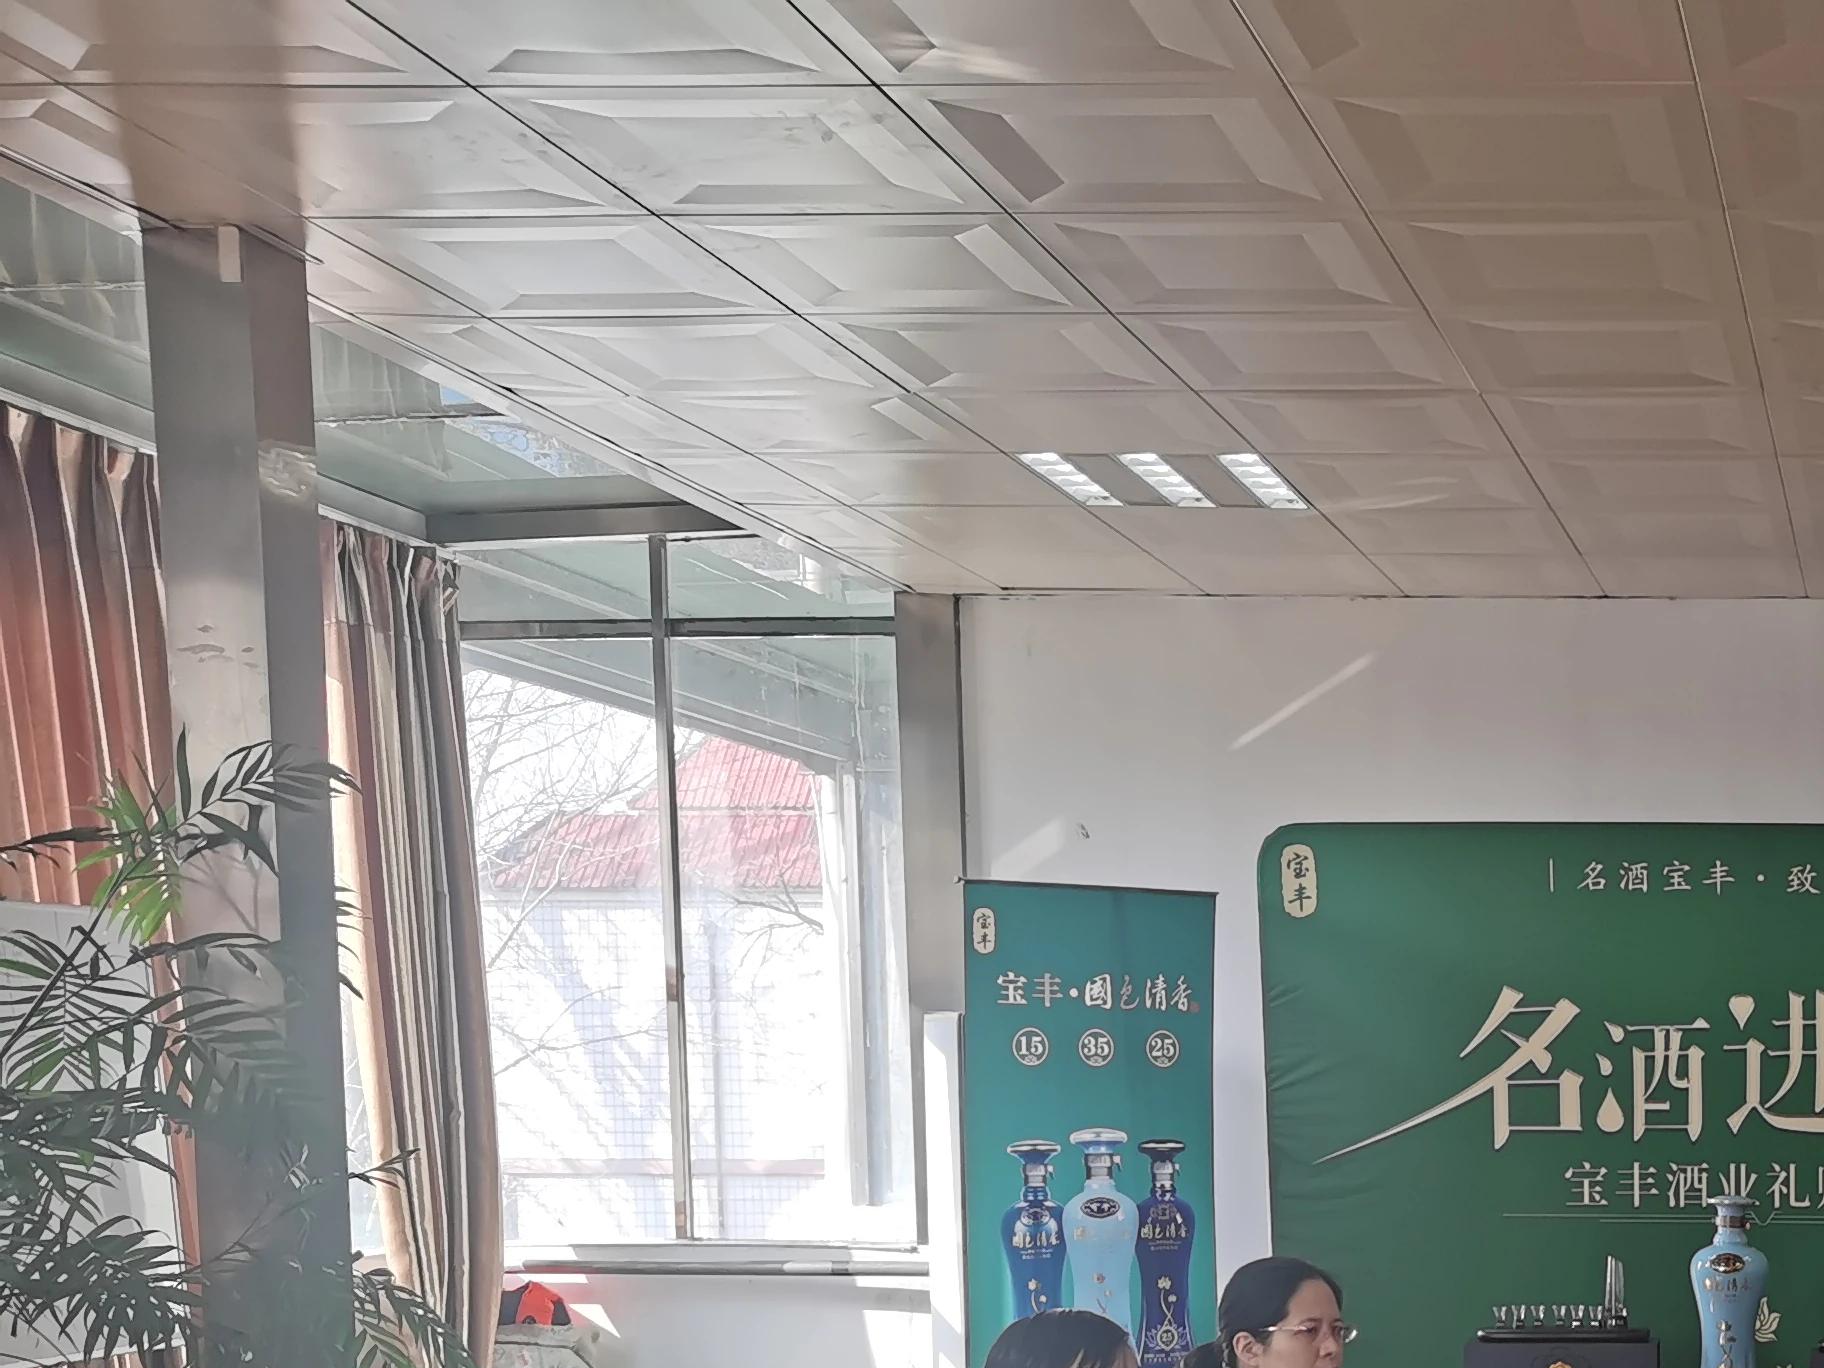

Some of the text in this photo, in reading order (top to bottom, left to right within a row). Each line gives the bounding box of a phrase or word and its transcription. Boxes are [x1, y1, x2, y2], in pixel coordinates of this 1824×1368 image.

[1285, 850, 1314, 914] 宝丰
[975, 911, 993, 951] 宝丰
[1018, 1035, 1044, 1056] 15
[1083, 1036, 1110, 1057] 35
[1151, 1037, 1175, 1058] 25
